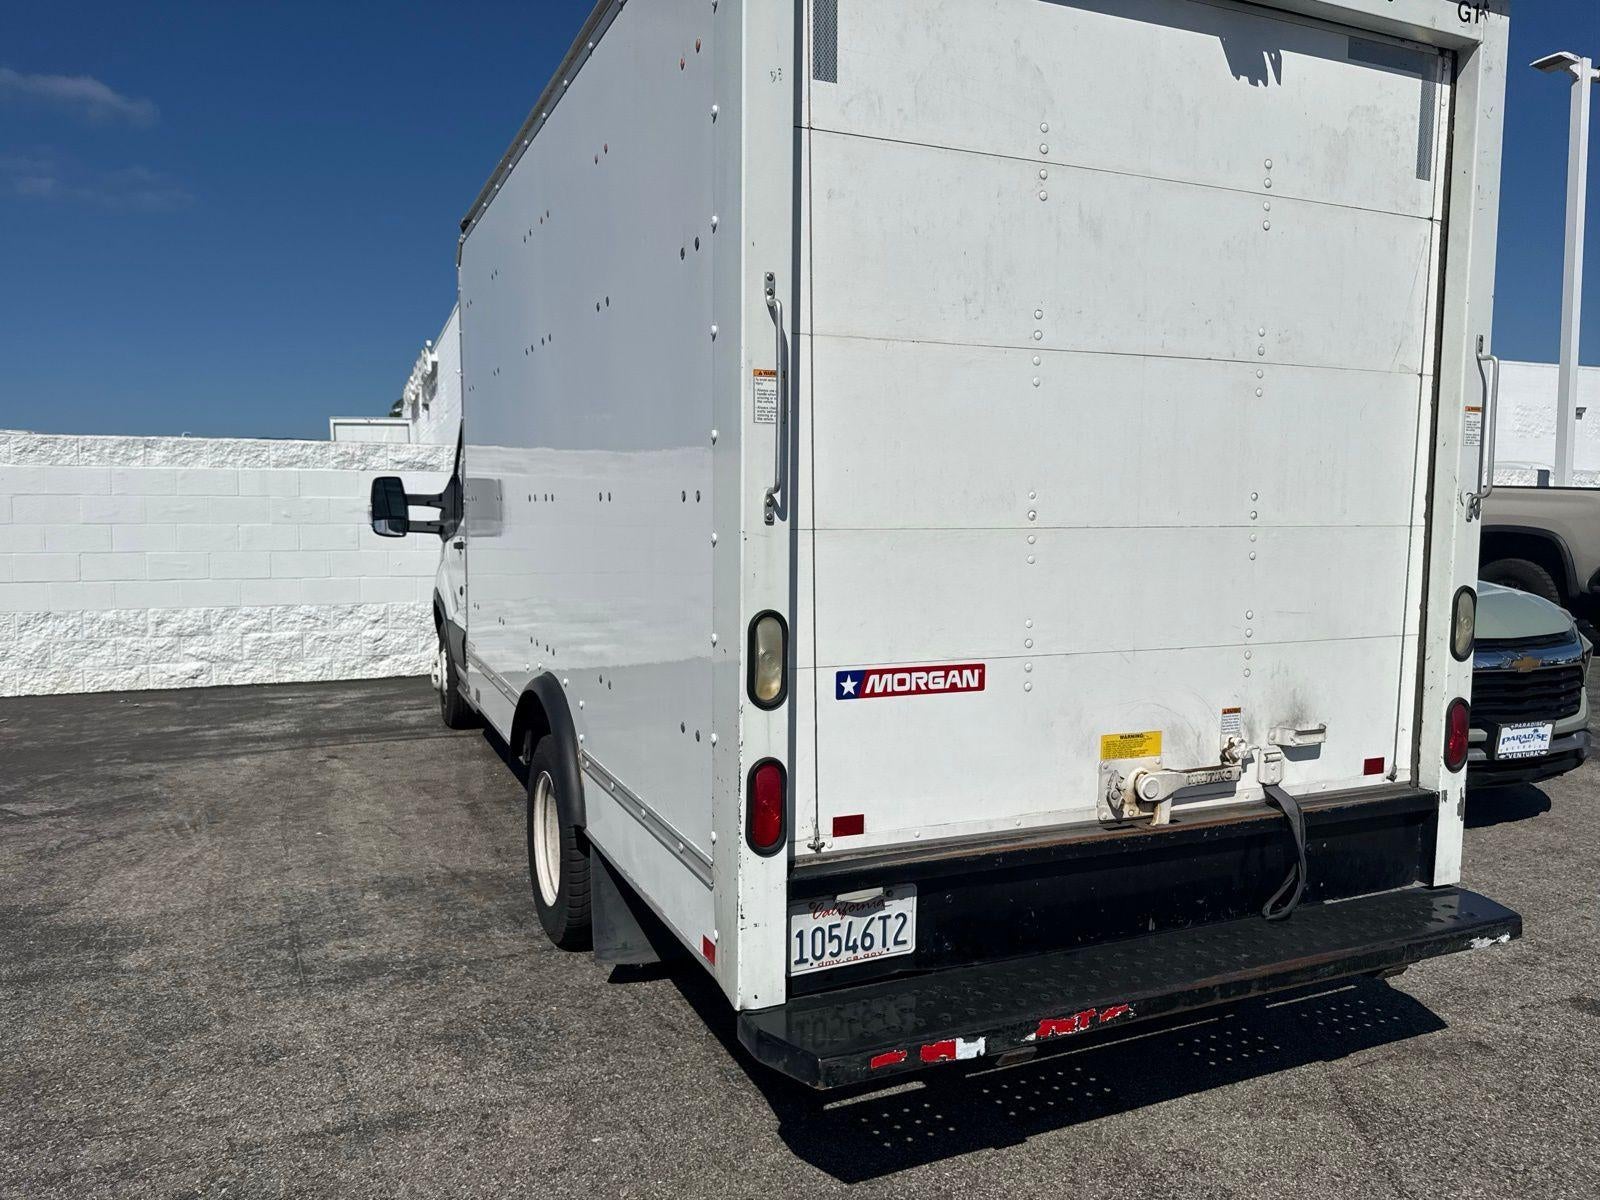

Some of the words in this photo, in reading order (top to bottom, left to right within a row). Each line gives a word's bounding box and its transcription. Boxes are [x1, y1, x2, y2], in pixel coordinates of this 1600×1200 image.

[864, 669, 980, 694] MORGAN
[811, 899, 886, 920] California
[793, 911, 908, 966] 10546T2
[817, 950, 884, 968] dmv.ca.gov
